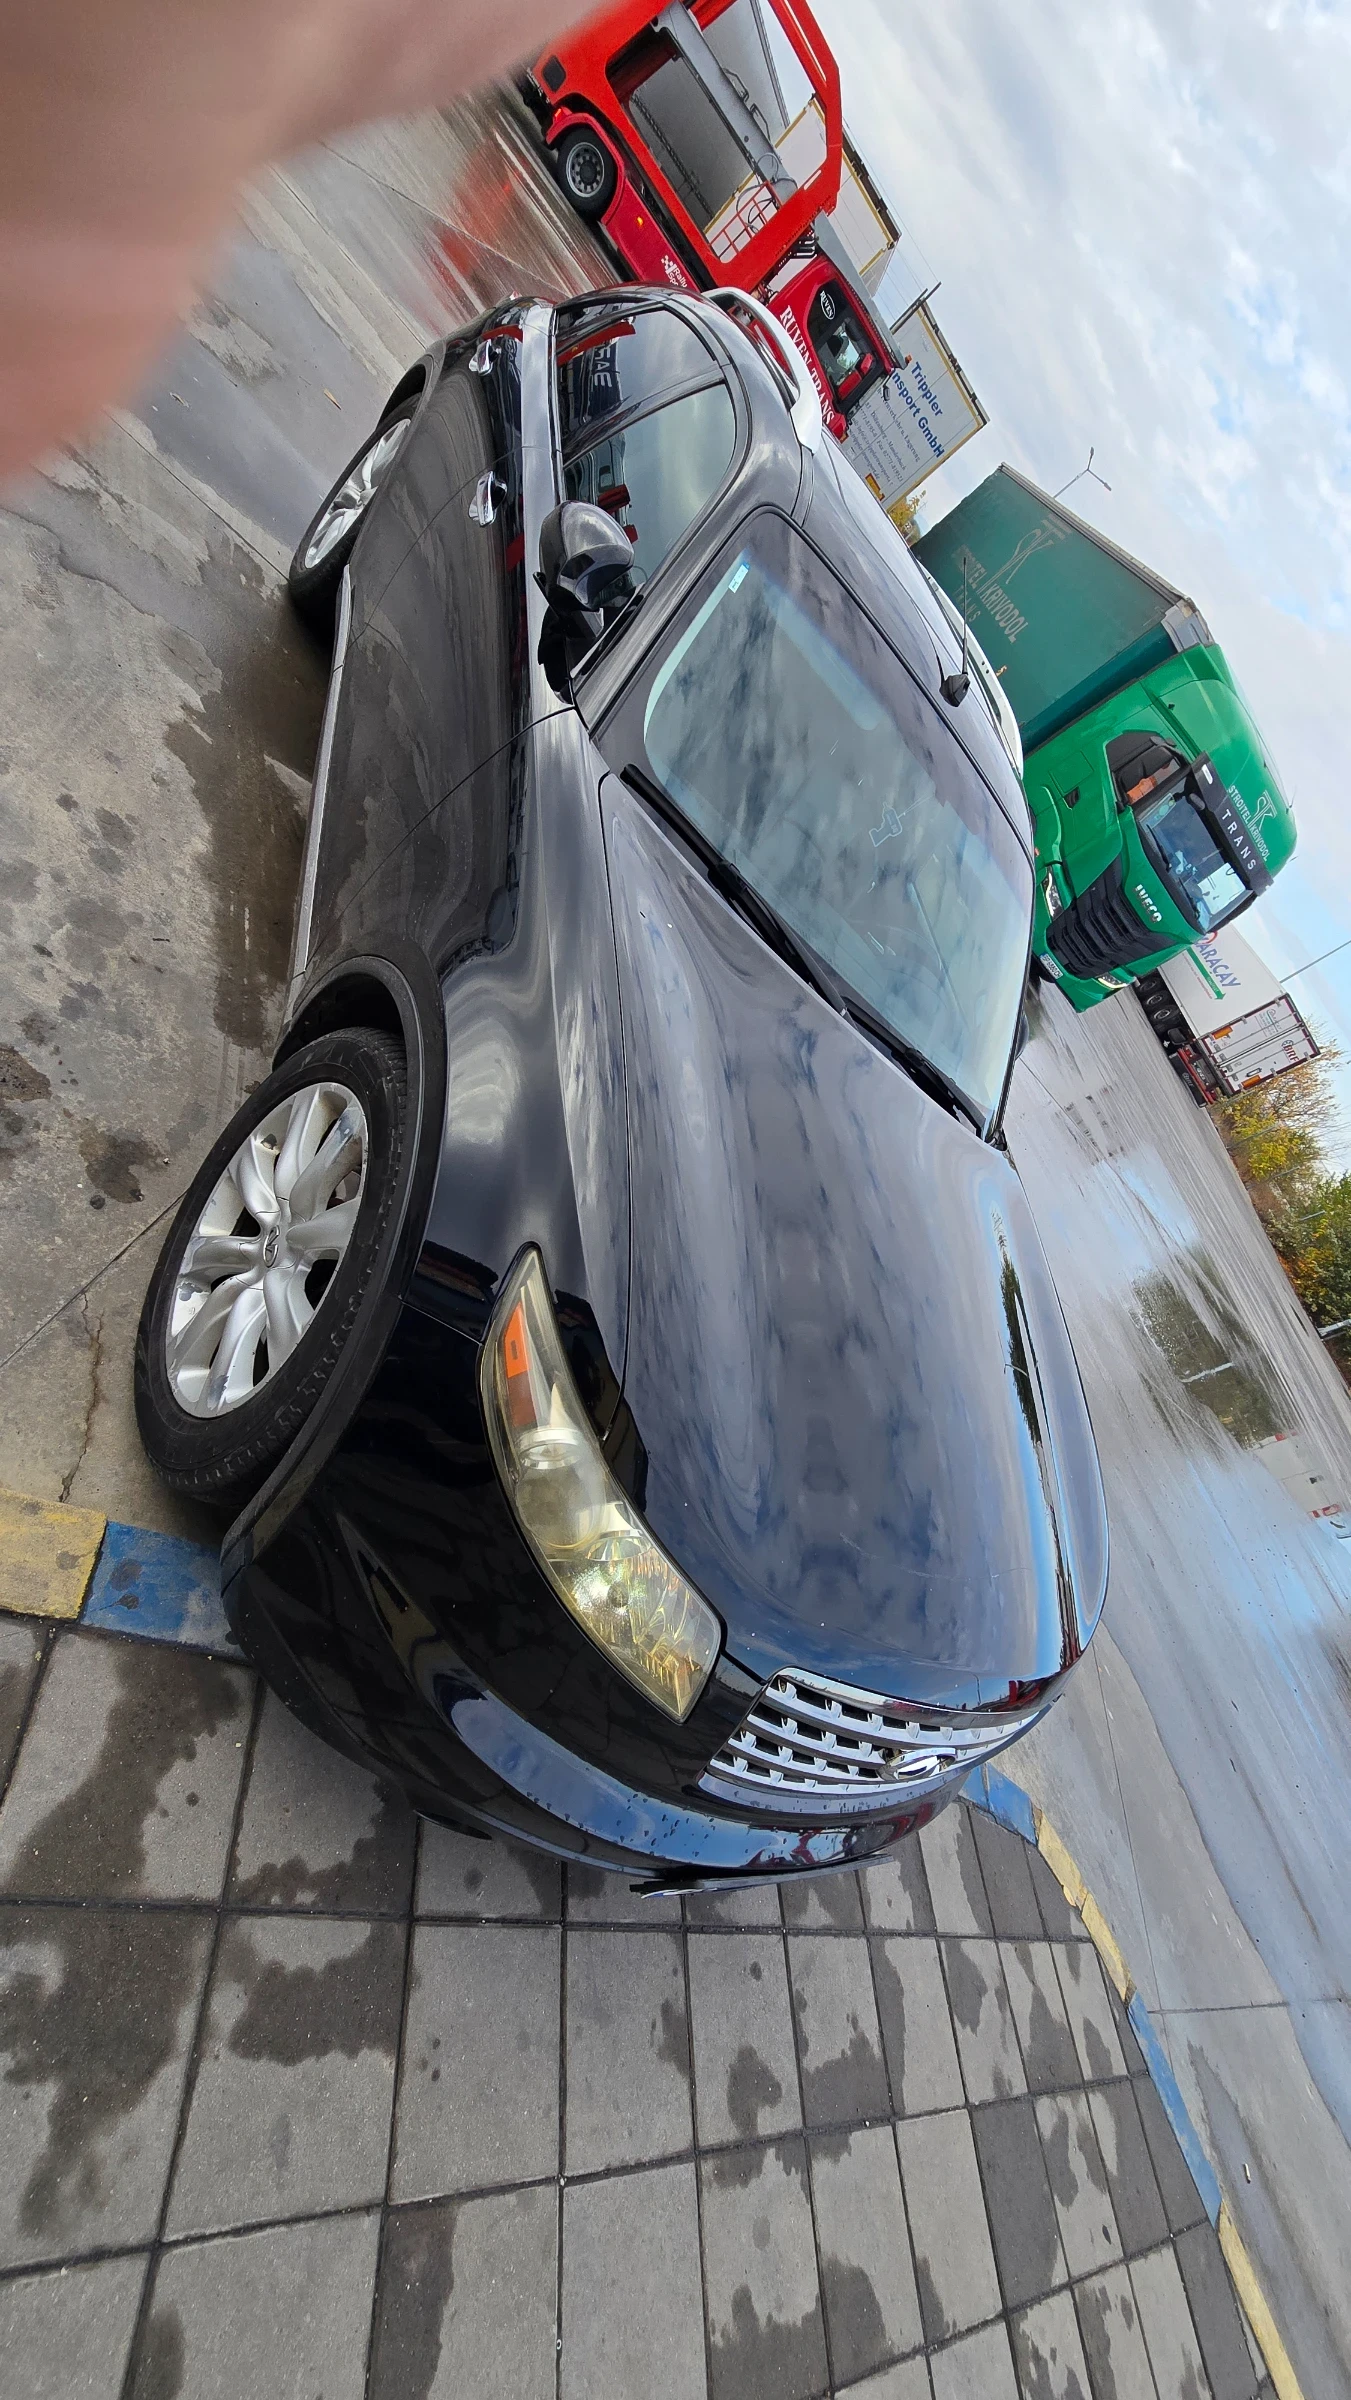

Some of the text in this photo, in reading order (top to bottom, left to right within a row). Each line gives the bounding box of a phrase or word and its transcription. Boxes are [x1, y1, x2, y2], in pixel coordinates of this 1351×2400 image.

[892, 371, 946, 459] nsport GmbH
[911, 361, 943, 417] Trippler
[979, 583, 1029, 644] KRIVODOL
[1221, 808, 1257, 870] TRANS
[1228, 785, 1271, 862] STROITEL KRIVODOL
[1134, 884, 1161, 922] IVECO
[1282, 1044, 1299, 1061] BRF
